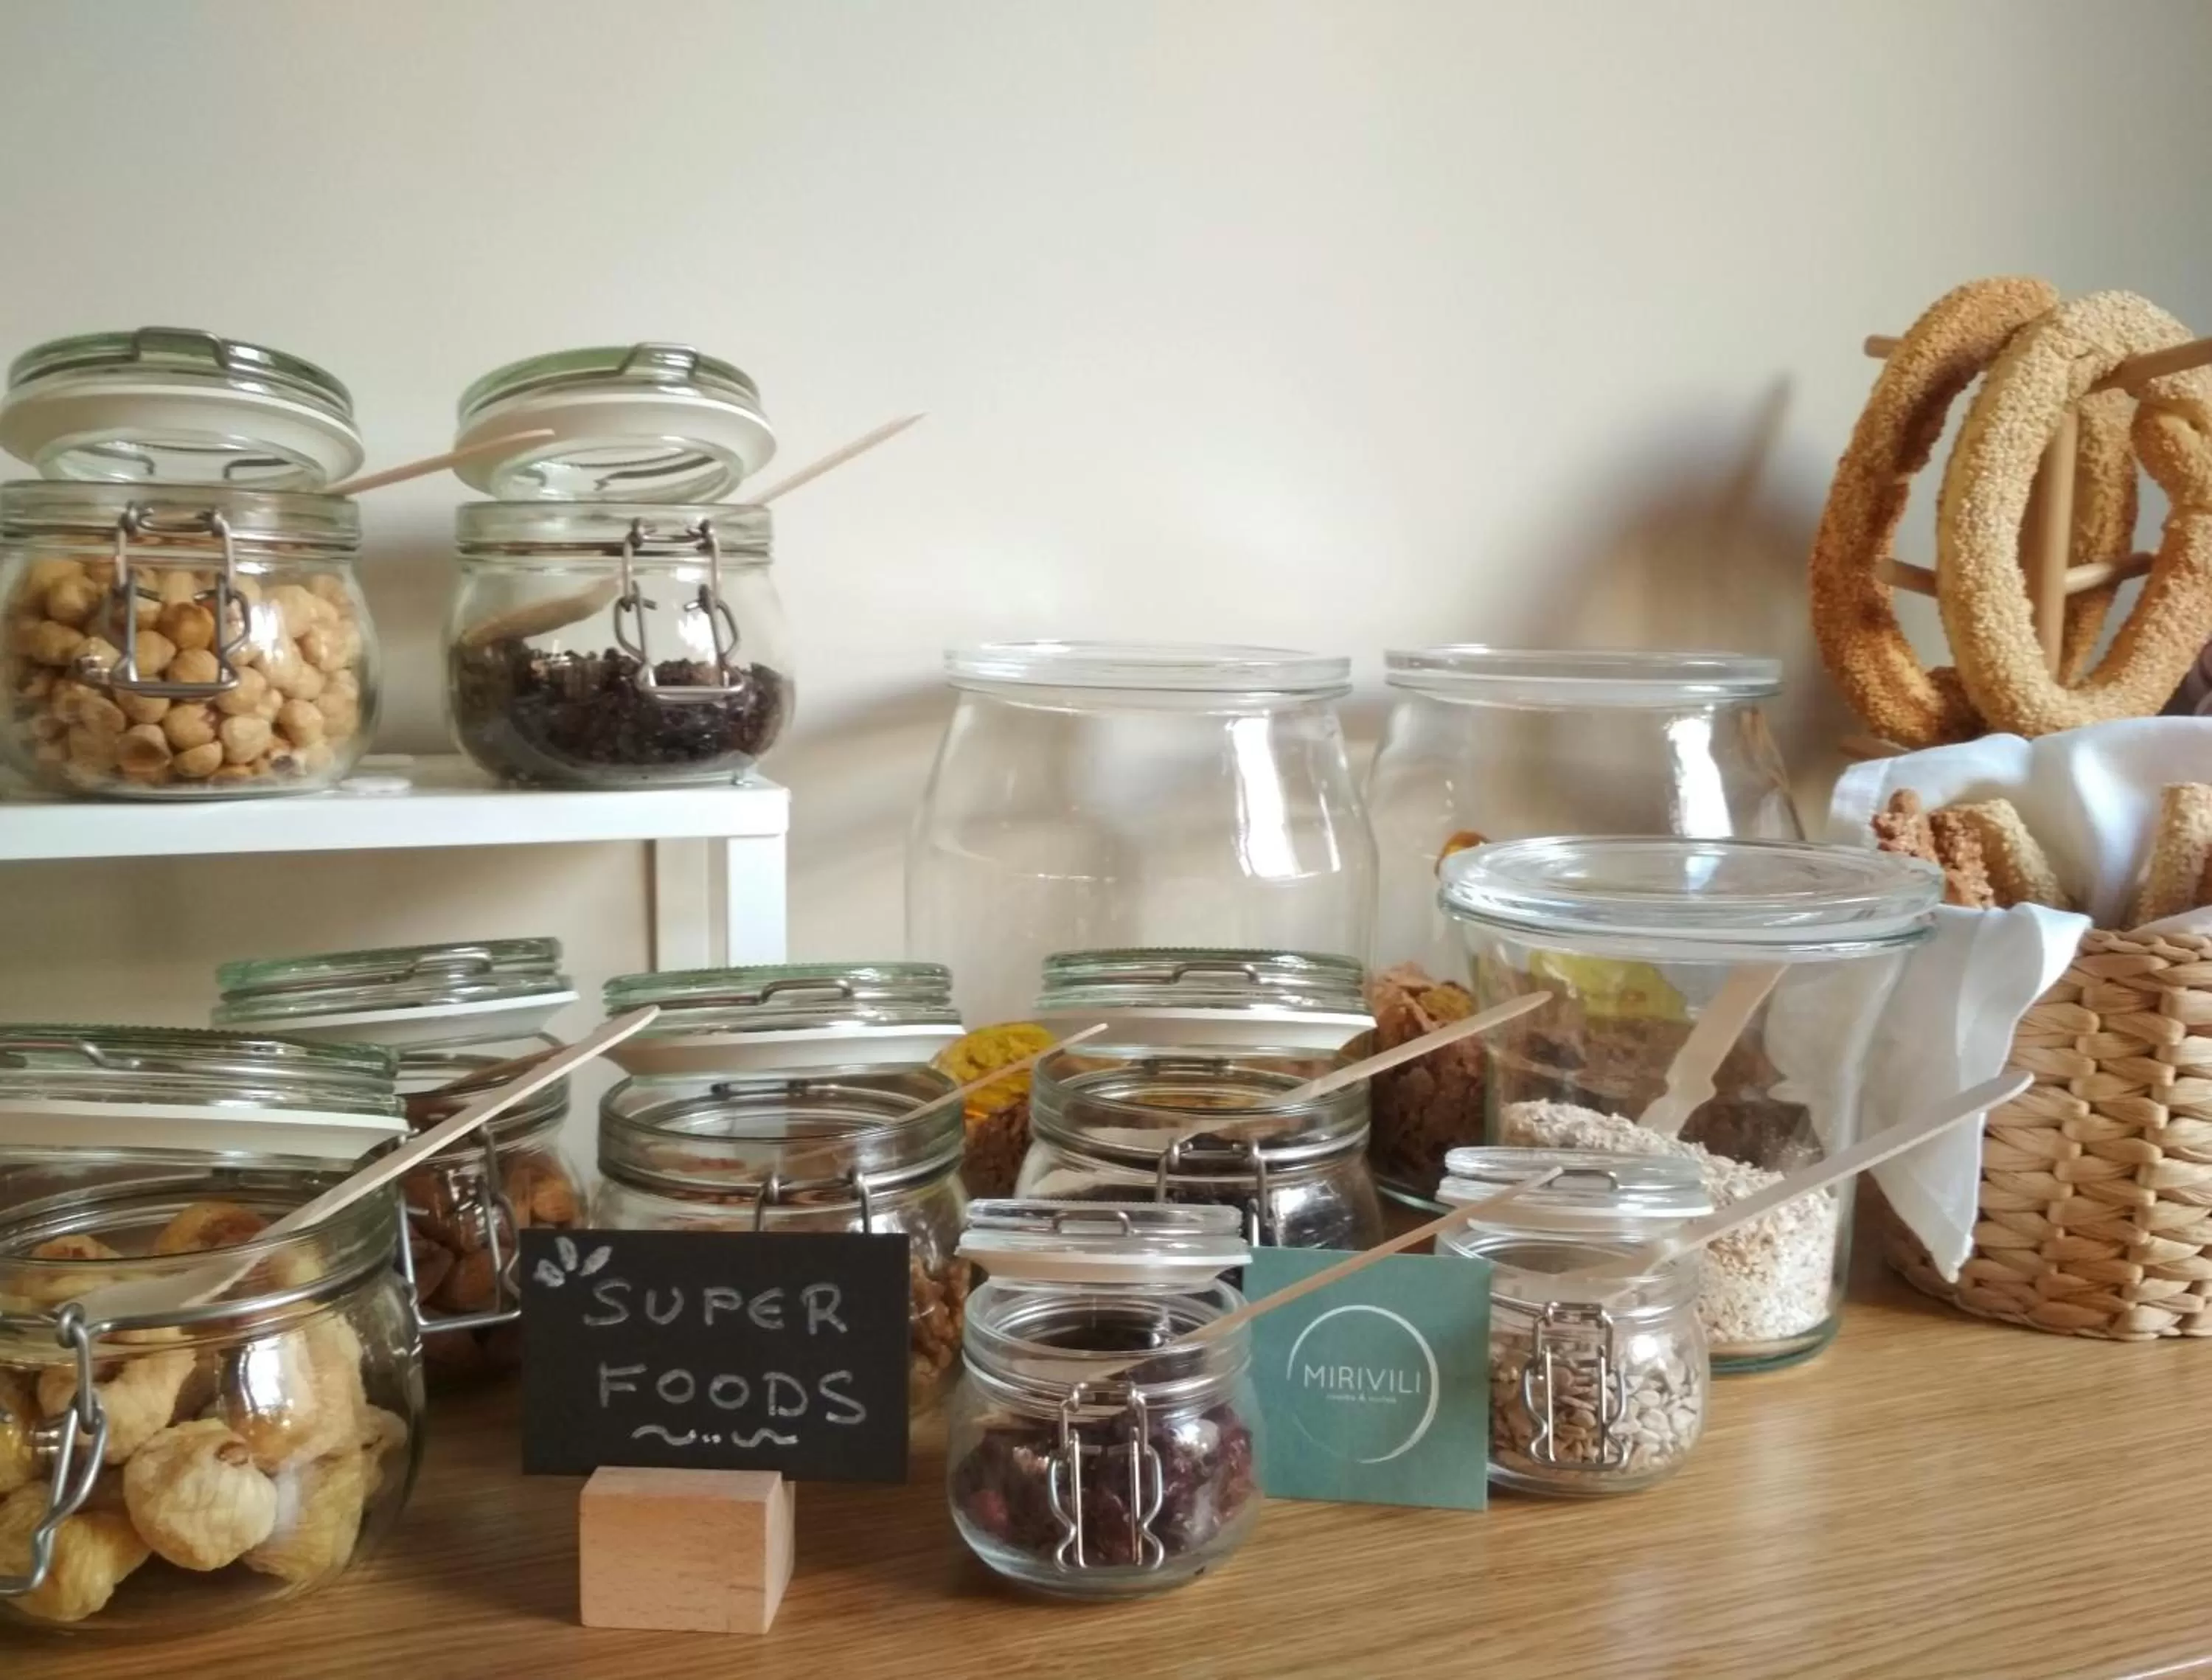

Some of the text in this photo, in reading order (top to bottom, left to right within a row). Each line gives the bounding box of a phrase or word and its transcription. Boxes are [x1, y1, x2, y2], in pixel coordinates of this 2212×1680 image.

[583, 1278, 848, 1334] SUPER
[599, 1362, 866, 1423] FOODS
[1304, 1364, 1421, 1393] MIRIVILI
